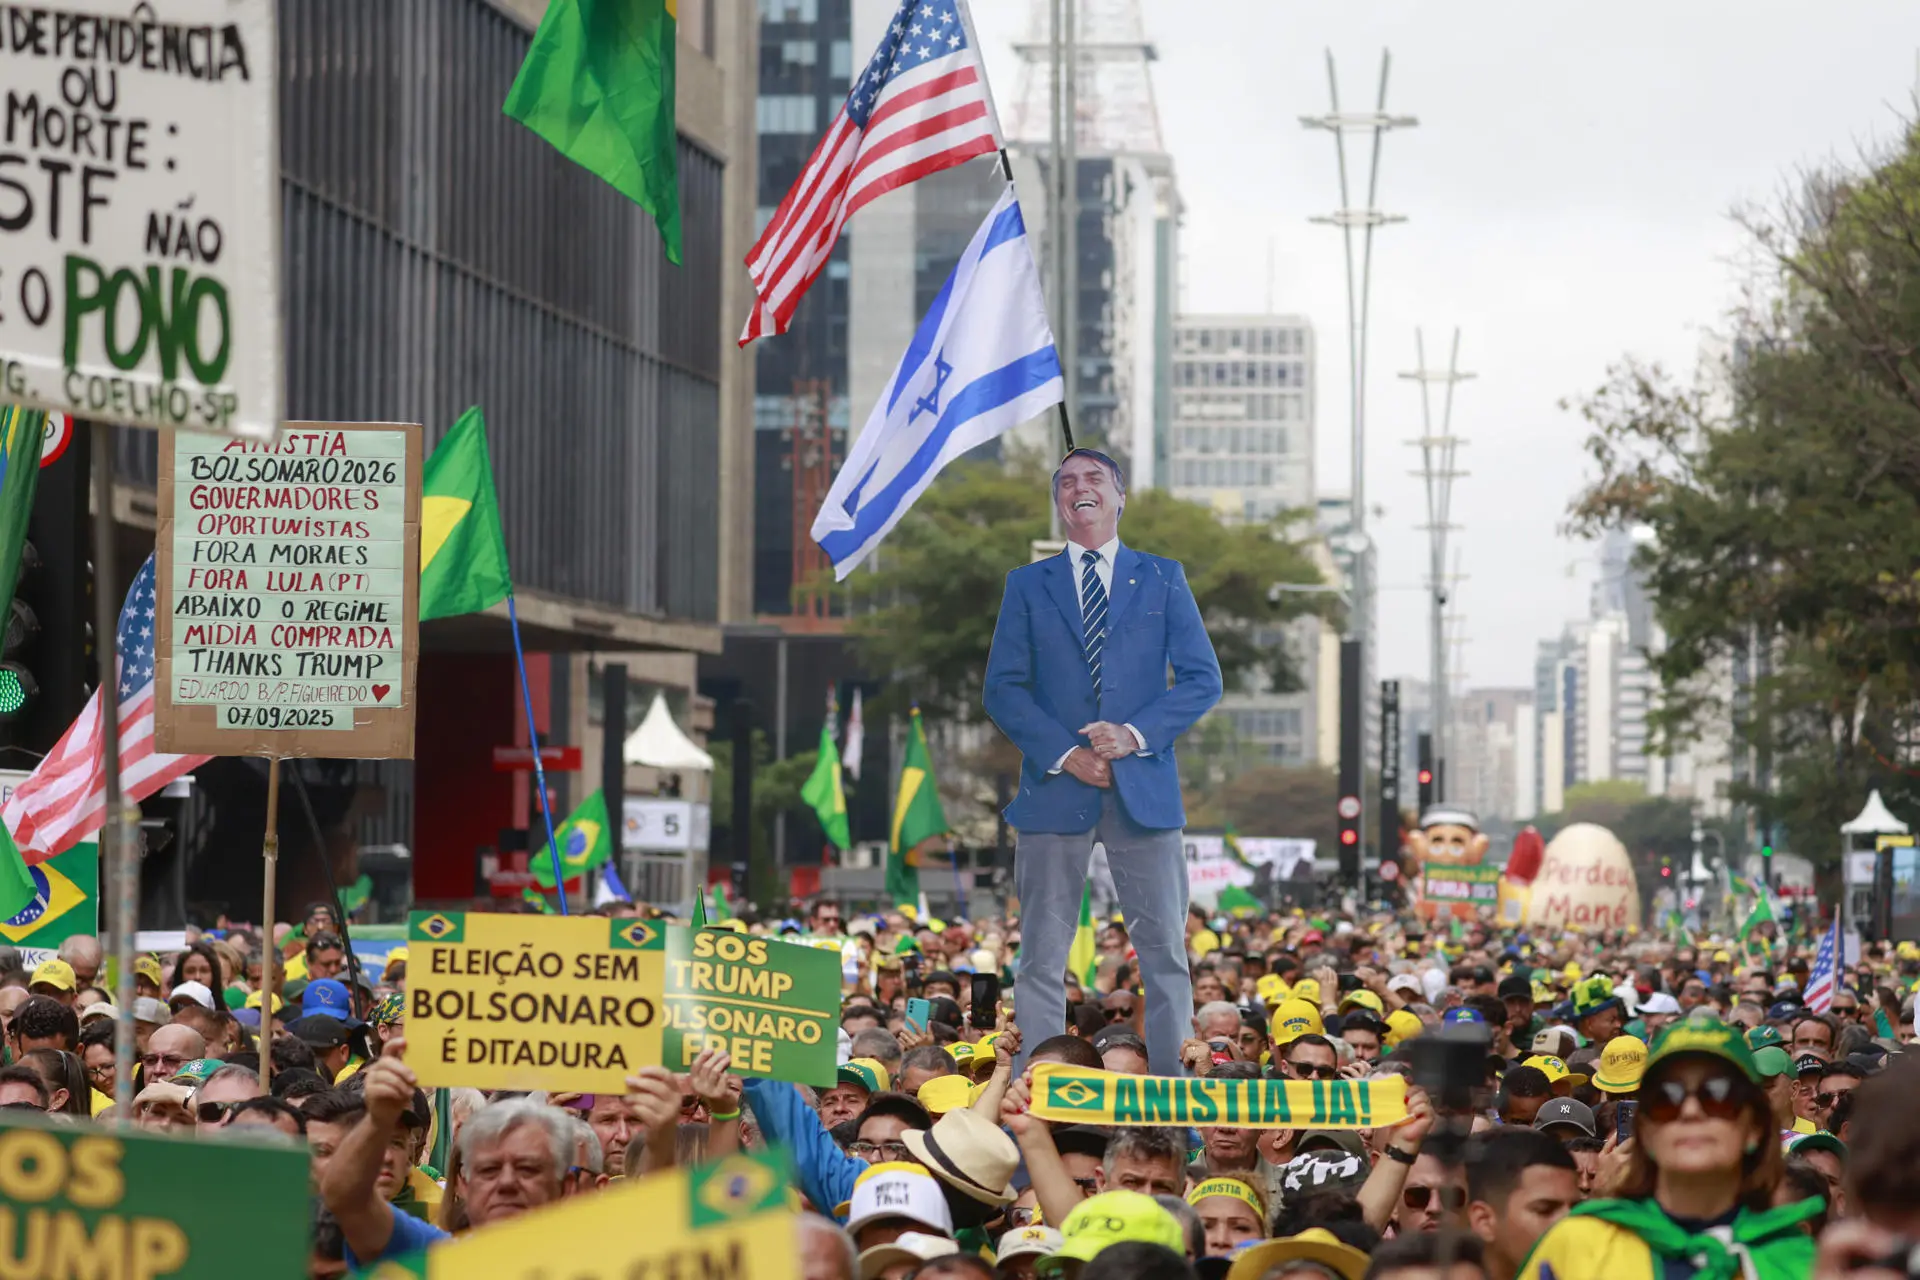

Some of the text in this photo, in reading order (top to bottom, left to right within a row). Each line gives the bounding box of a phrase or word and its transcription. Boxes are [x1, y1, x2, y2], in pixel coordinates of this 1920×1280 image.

[0, 1, 249, 82] DEPENDÊNCIA
[61, 66, 116, 113] OU
[0, 153, 222, 264] STF NÃO
[20, 253, 230, 385] O POVO
[189, 484, 380, 511] GOVERNADORES
[192, 540, 368, 566] FORA MORAES
[187, 568, 249, 591] FORA
[281, 600, 295, 618] O
[271, 624, 394, 649] COMPRADA
[188, 648, 384, 679] THANKS TRUMP
[178, 678, 249, 701] EDUARDO
[227, 706, 334, 729] 07/09/2025
[664, 813, 679, 837] 5
[1545, 857, 1629, 886] Perdeu
[1543, 892, 1628, 928] Mané
[431, 943, 639, 985] ELEIÇÃO SEM
[693, 931, 768, 966] SOS
[671, 959, 793, 1000] TRUMP
[412, 989, 655, 1028] BOLSONARO
[442, 1028, 629, 1070] É DITADURA
[1114, 1078, 1372, 1125] ANISTIA JA!
[0, 1128, 124, 1209] OS
[0, 1205, 188, 1280] UMP
